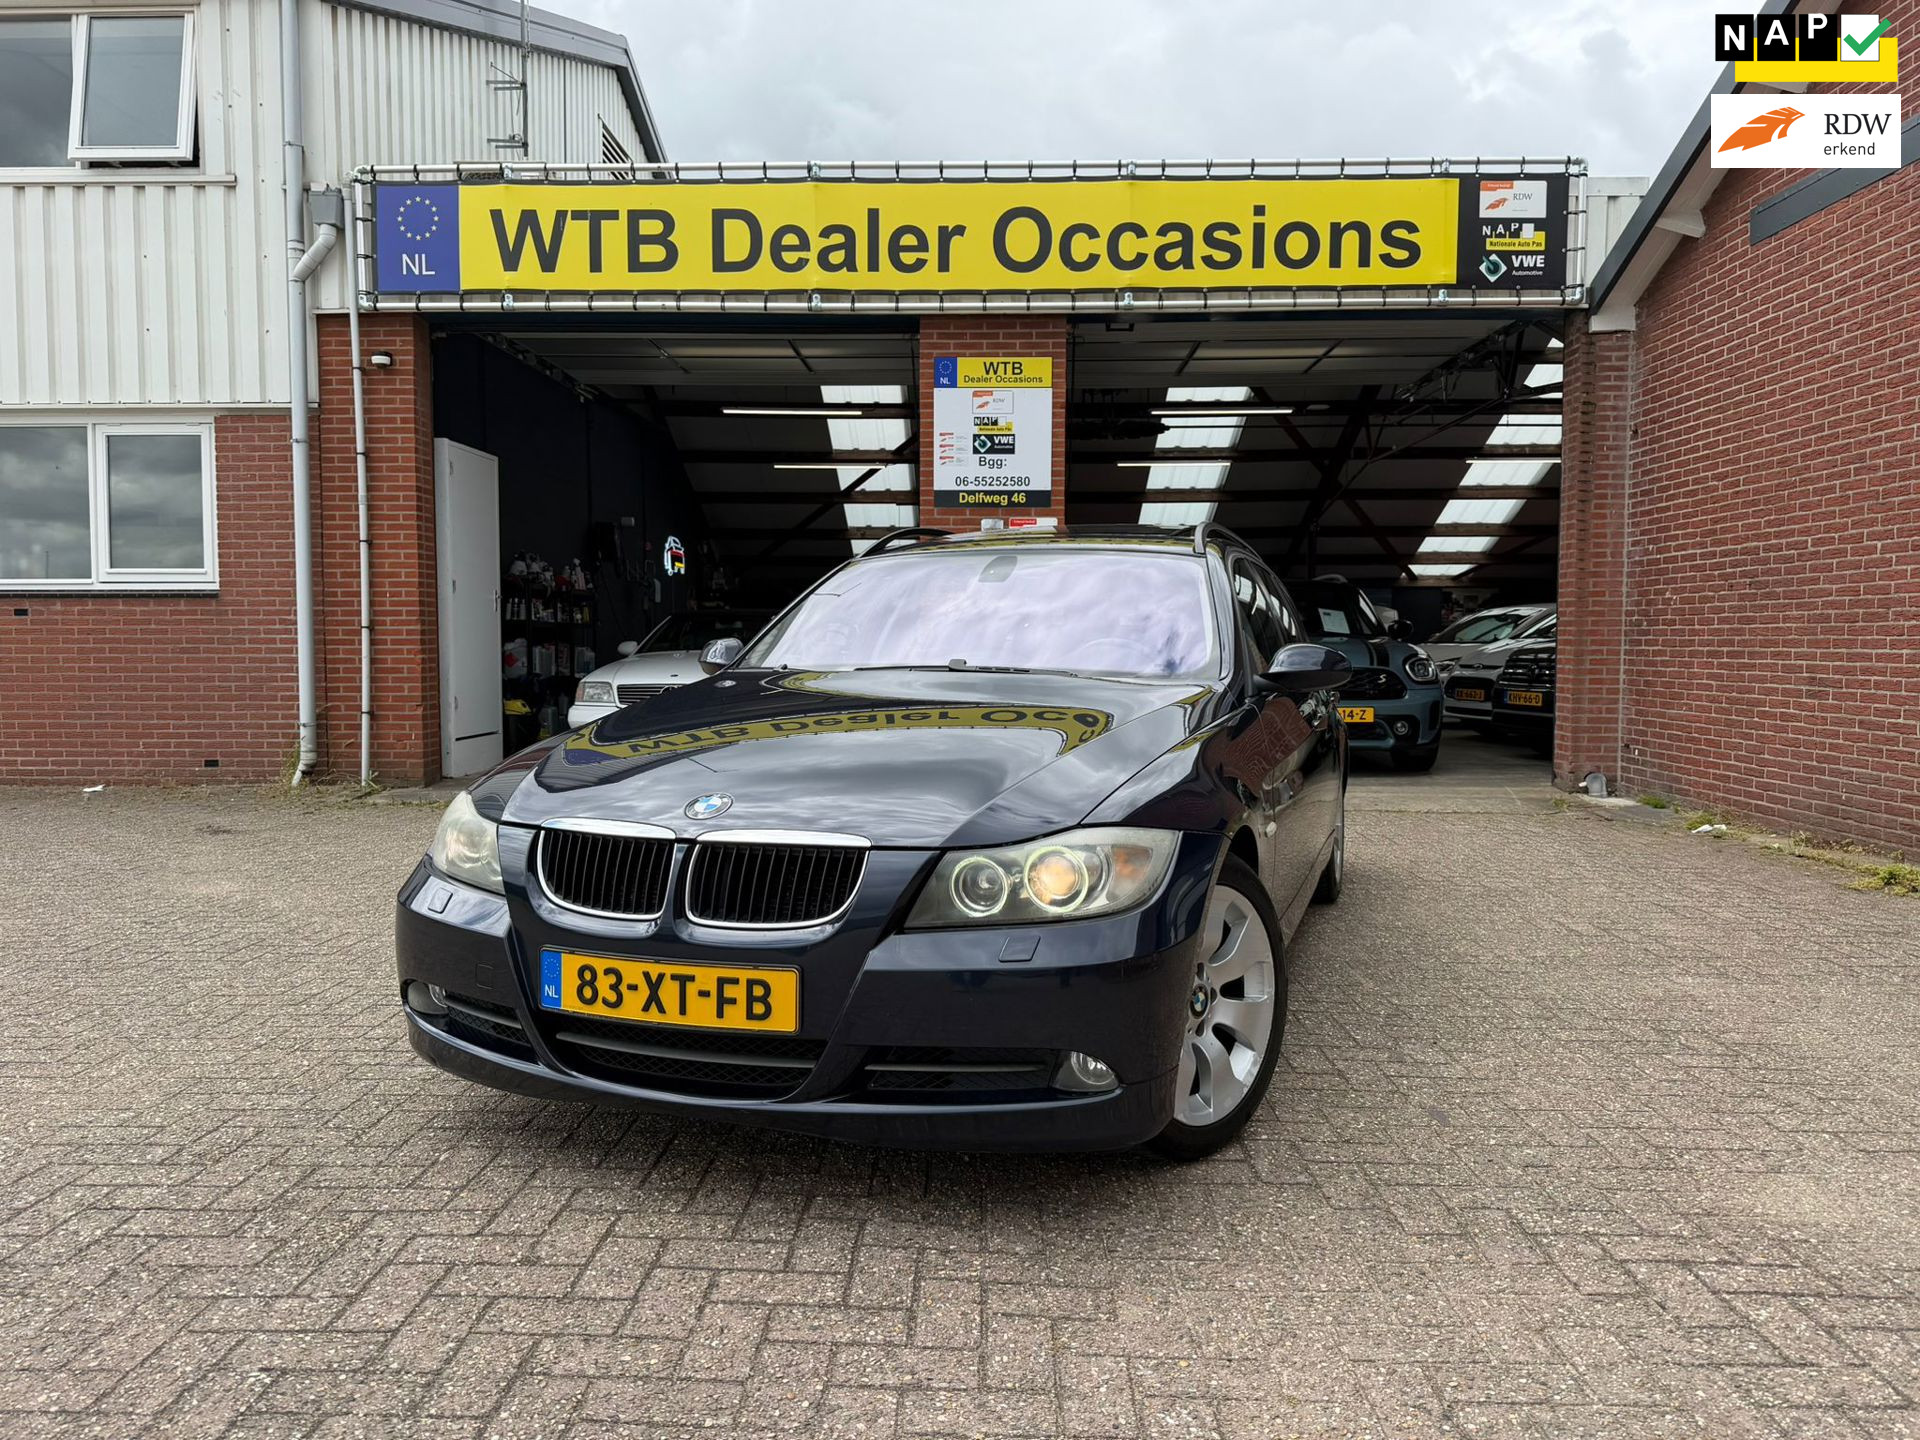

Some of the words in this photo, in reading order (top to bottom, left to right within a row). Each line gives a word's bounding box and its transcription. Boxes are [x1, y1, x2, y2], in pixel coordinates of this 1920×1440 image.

[1513, 193, 1533, 201] RDW
[489, 208, 680, 275] WTB
[711, 206, 966, 274] Dealer
[991, 204, 1423, 272] Occasions
[401, 253, 436, 276] NL
[1511, 254, 1545, 268] VWE
[983, 361, 1024, 375] WTB
[939, 377, 951, 385] NL
[963, 375, 993, 384] Dealer
[995, 375, 1043, 384] Occasions
[993, 436, 1015, 444] VWE
[978, 456, 1008, 469] Bgg:
[955, 476, 1031, 487] 06-55252580
[959, 492, 1009, 504] Delfweg
[1011, 492, 1026, 503] 46
[544, 983, 559, 999] NL
[575, 963, 773, 1022] 83-XT-FB
